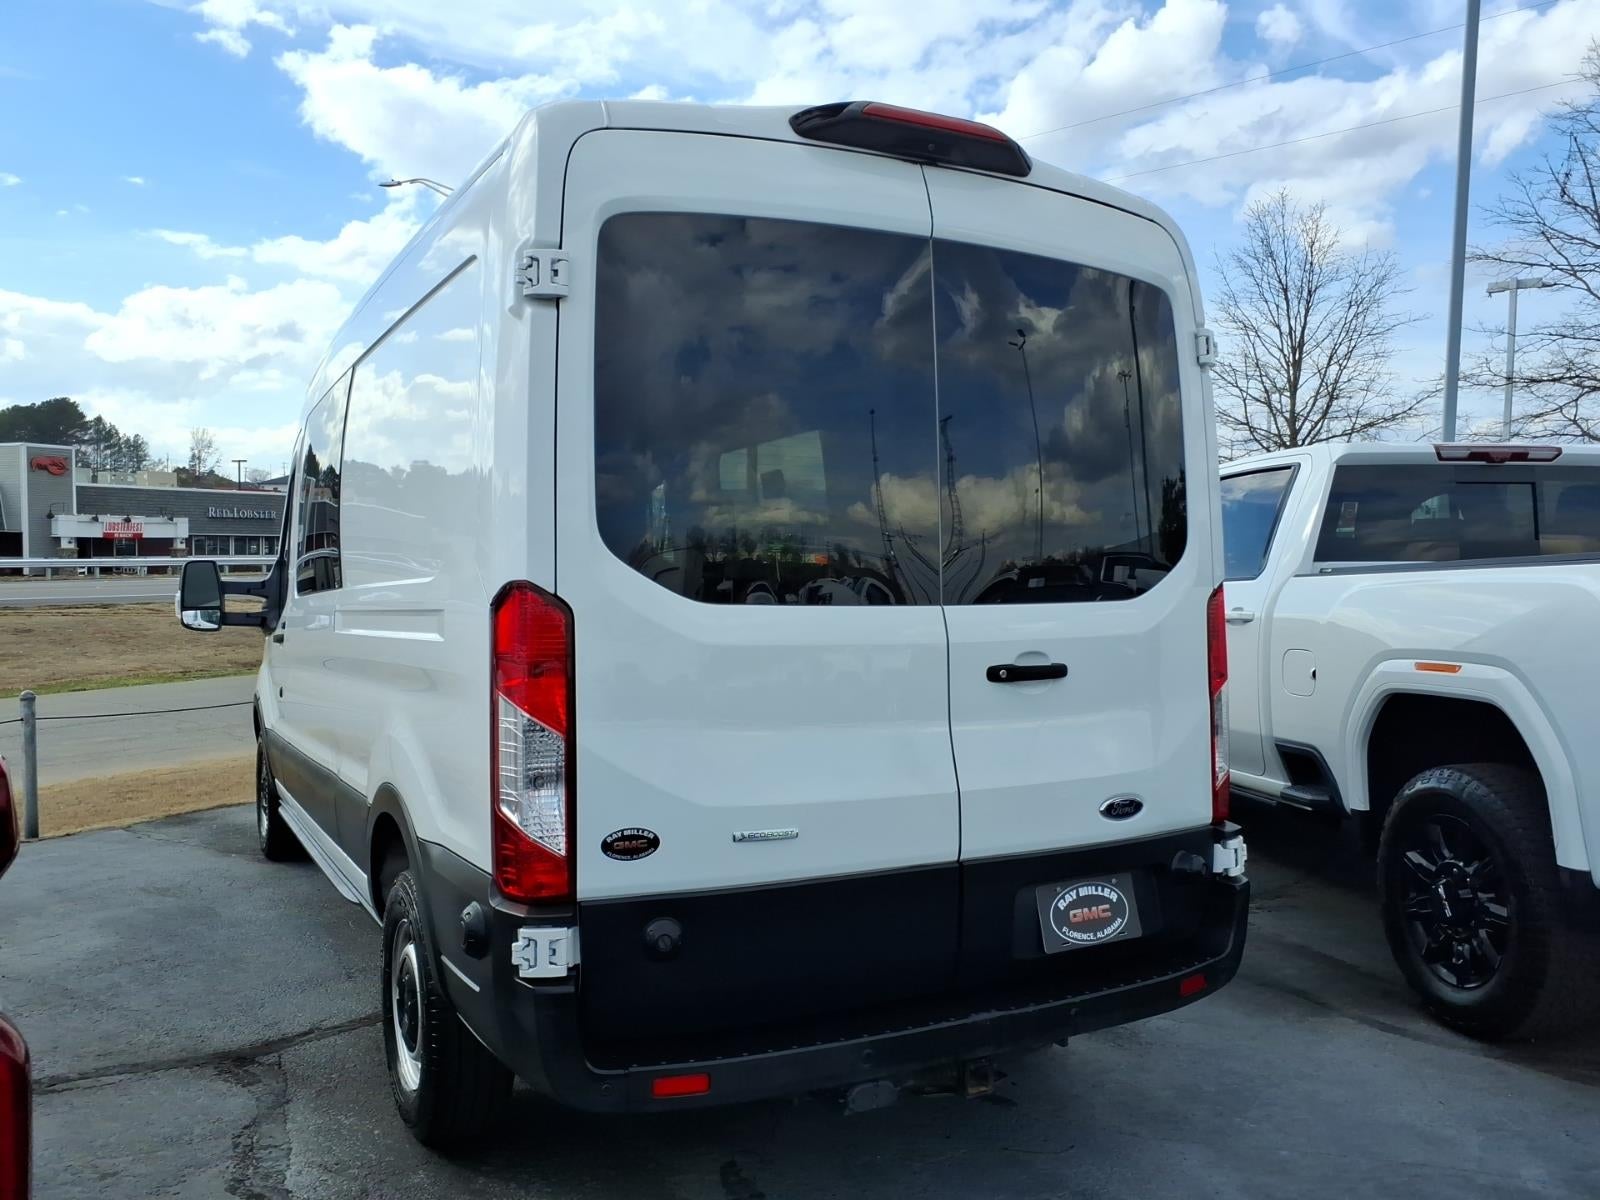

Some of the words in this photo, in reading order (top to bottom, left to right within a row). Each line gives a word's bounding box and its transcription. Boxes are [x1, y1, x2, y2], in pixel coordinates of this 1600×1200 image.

[234, 507, 277, 519] LOBSTER
[606, 831, 622, 843] RAY
[623, 829, 655, 839] MILLER
[613, 839, 648, 850] GMC
[1057, 889, 1077, 911] RAY
[1078, 885, 1118, 902] MILLER
[1069, 904, 1112, 923] GMC
[1096, 917, 1123, 938] ALABAMA
